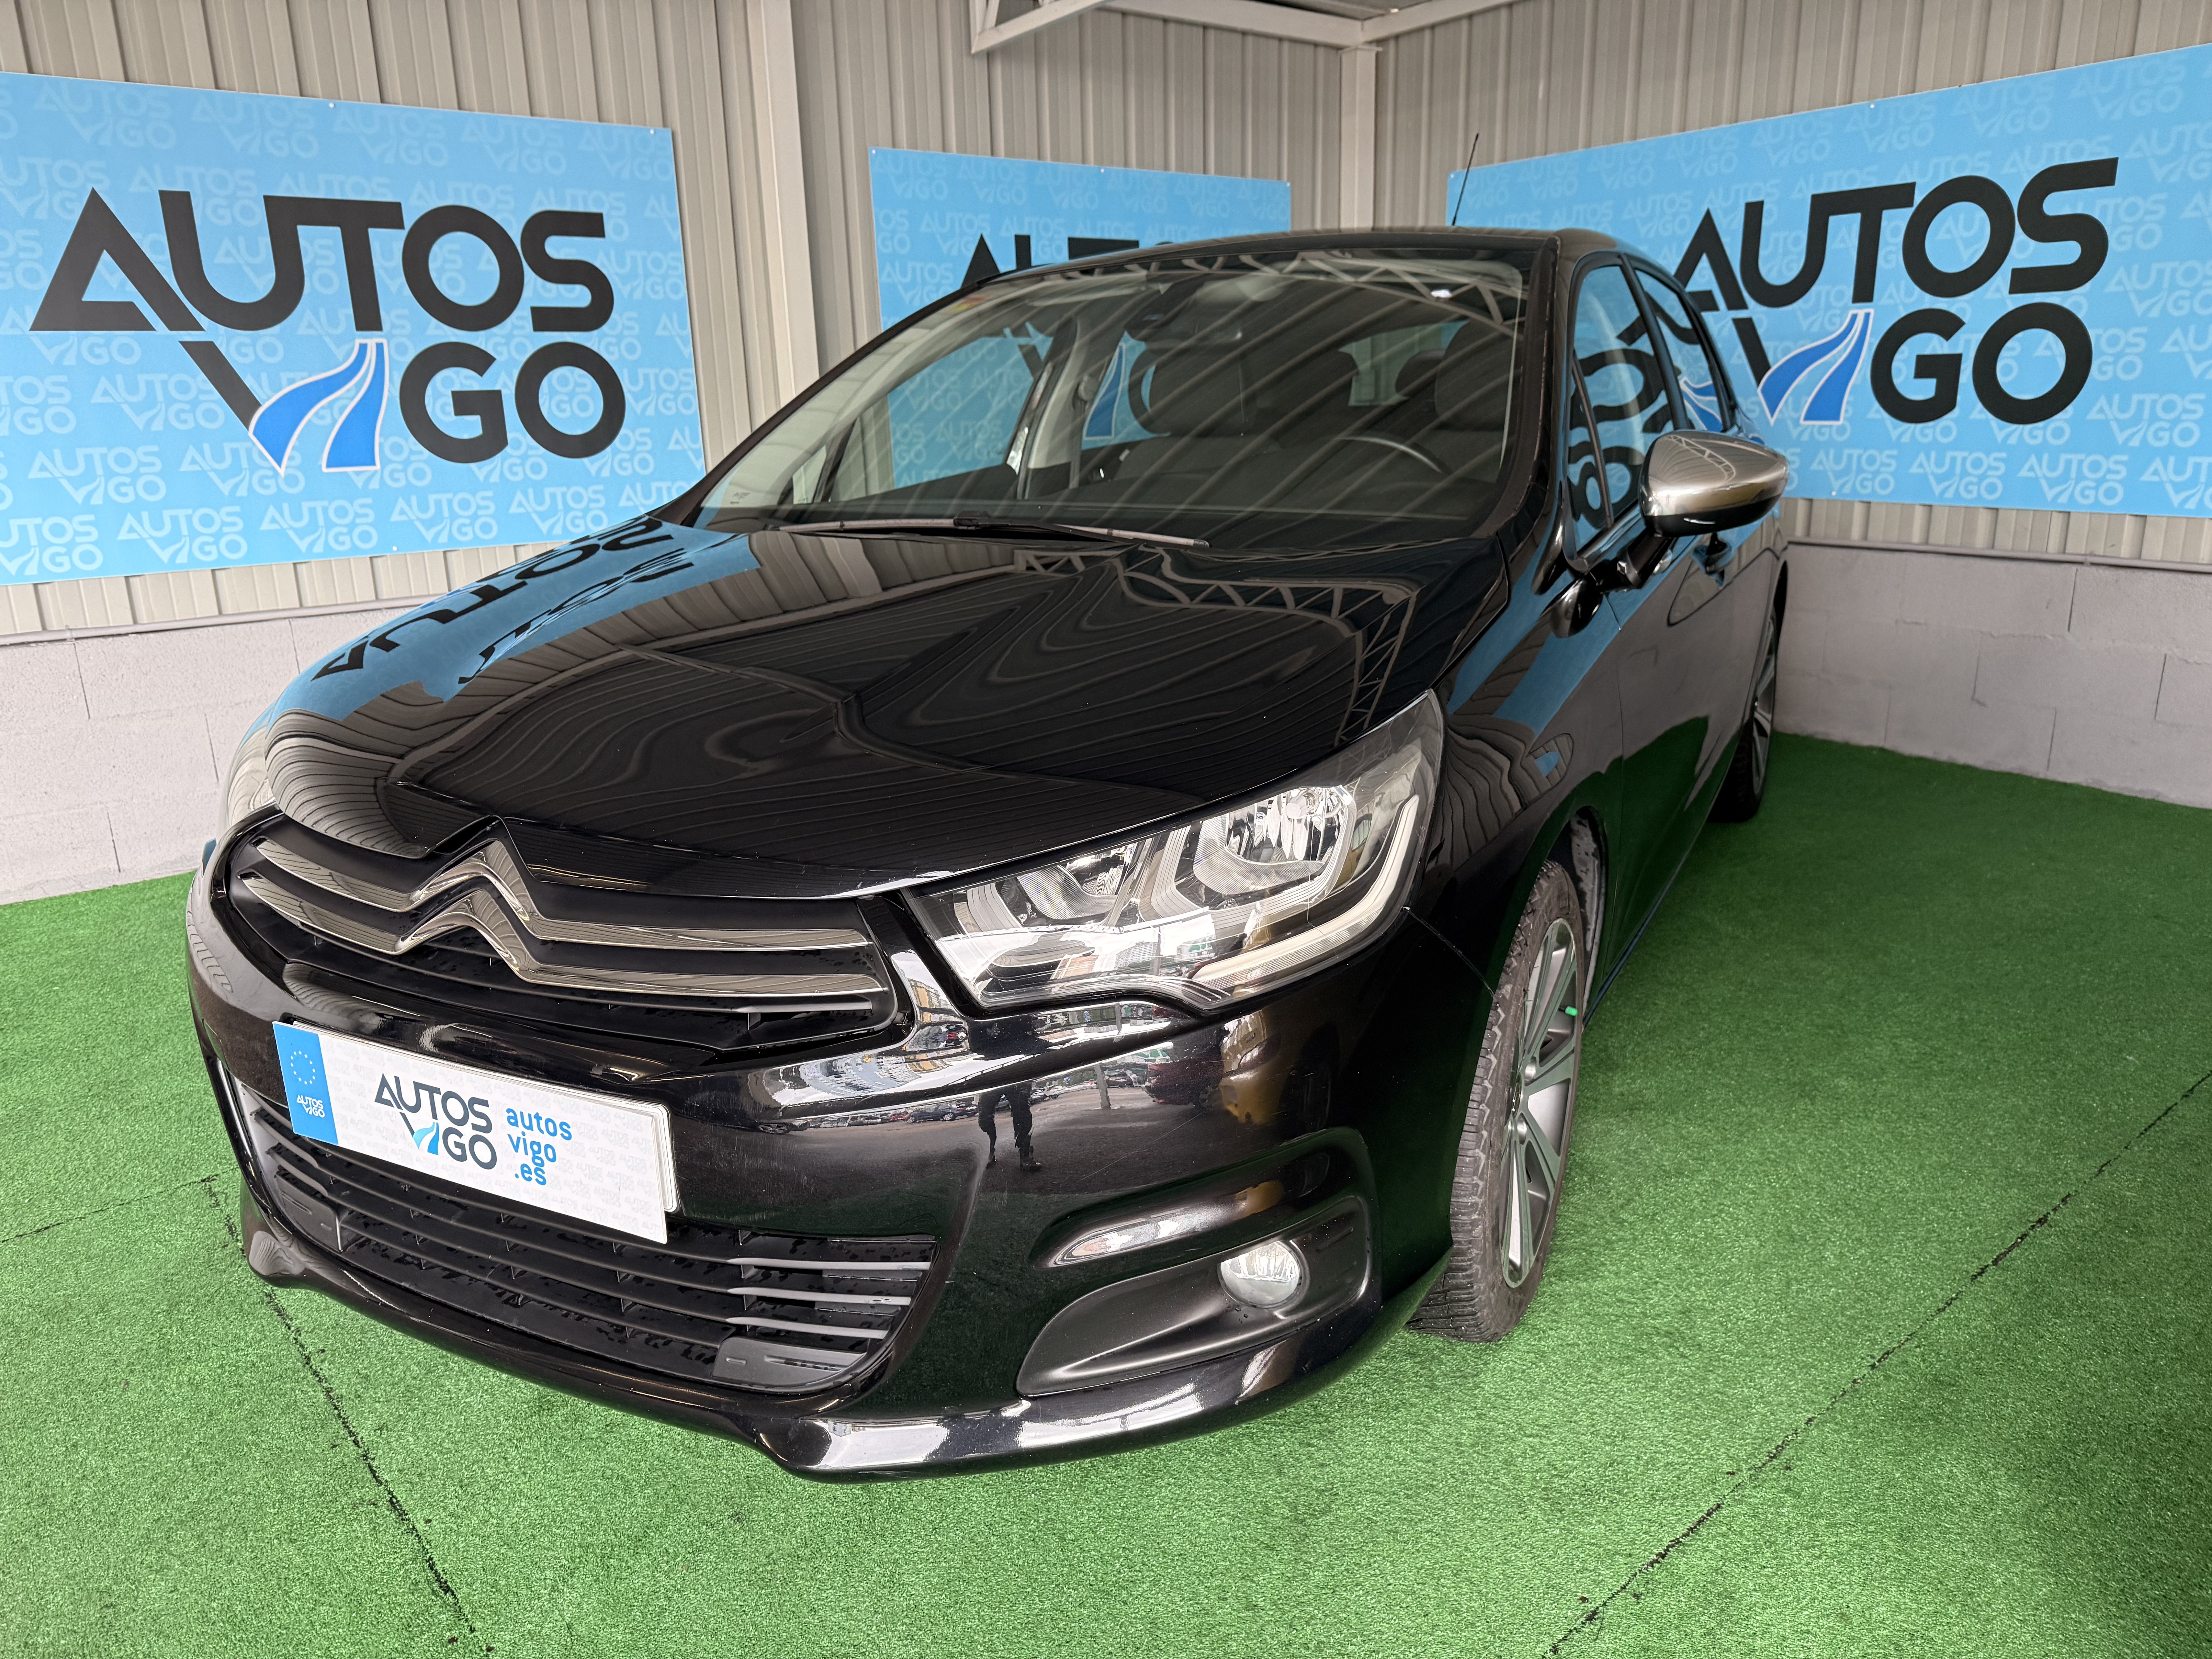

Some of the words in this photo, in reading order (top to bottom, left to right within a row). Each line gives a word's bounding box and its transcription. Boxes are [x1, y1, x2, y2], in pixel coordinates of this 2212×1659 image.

[2124, 122, 2212, 160] AUTO
[0, 156, 110, 191] UTOS
[2145, 151, 2212, 184] VIG
[0, 187, 114, 220] VIG
[1673, 156, 2119, 311] AUTOS
[29, 187, 615, 332] AUTOS
[30, 337, 142, 366] VIGO
[1731, 302, 2092, 425] VIGO
[623, 367, 694, 393] UTOS
[121, 402, 225, 431] VIGO
[178, 337, 626, 477] VIGO
[2085, 394, 2206, 421] AUTOS
[2111, 422, 2203, 448] VIGO
[28, 445, 163, 479] AUTOS
[1810, 449, 1898, 471] AUTOS
[1908, 452, 2008, 474] AUTOS
[2018, 455, 2129, 479] AUTOS
[58, 475, 167, 505] VIGO
[508, 484, 606, 514] AUTOS
[1929, 476, 2004, 501] VIGO
[2040, 480, 2124, 506] VIGO
[260, 498, 375, 531] AUTOS
[389, 490, 496, 522] AUTOS
[0, 515, 99, 547] UTOS
[117, 506, 244, 540] AUTOS
[413, 515, 498, 543] VIGO
[530, 508, 608, 536] VIGO
[144, 535, 247, 564] VIGO
[284, 525, 378, 553] VIGO
[296, 1094, 324, 1109] AUTOS
[303, 1106, 325, 1118] VIGO
[374, 1073, 493, 1134] AUTOS
[506, 1108, 572, 1141] autos
[399, 1111, 497, 1170] VIGO
[507, 1131, 557, 1167] vigo
[515, 1163, 547, 1185] .es
